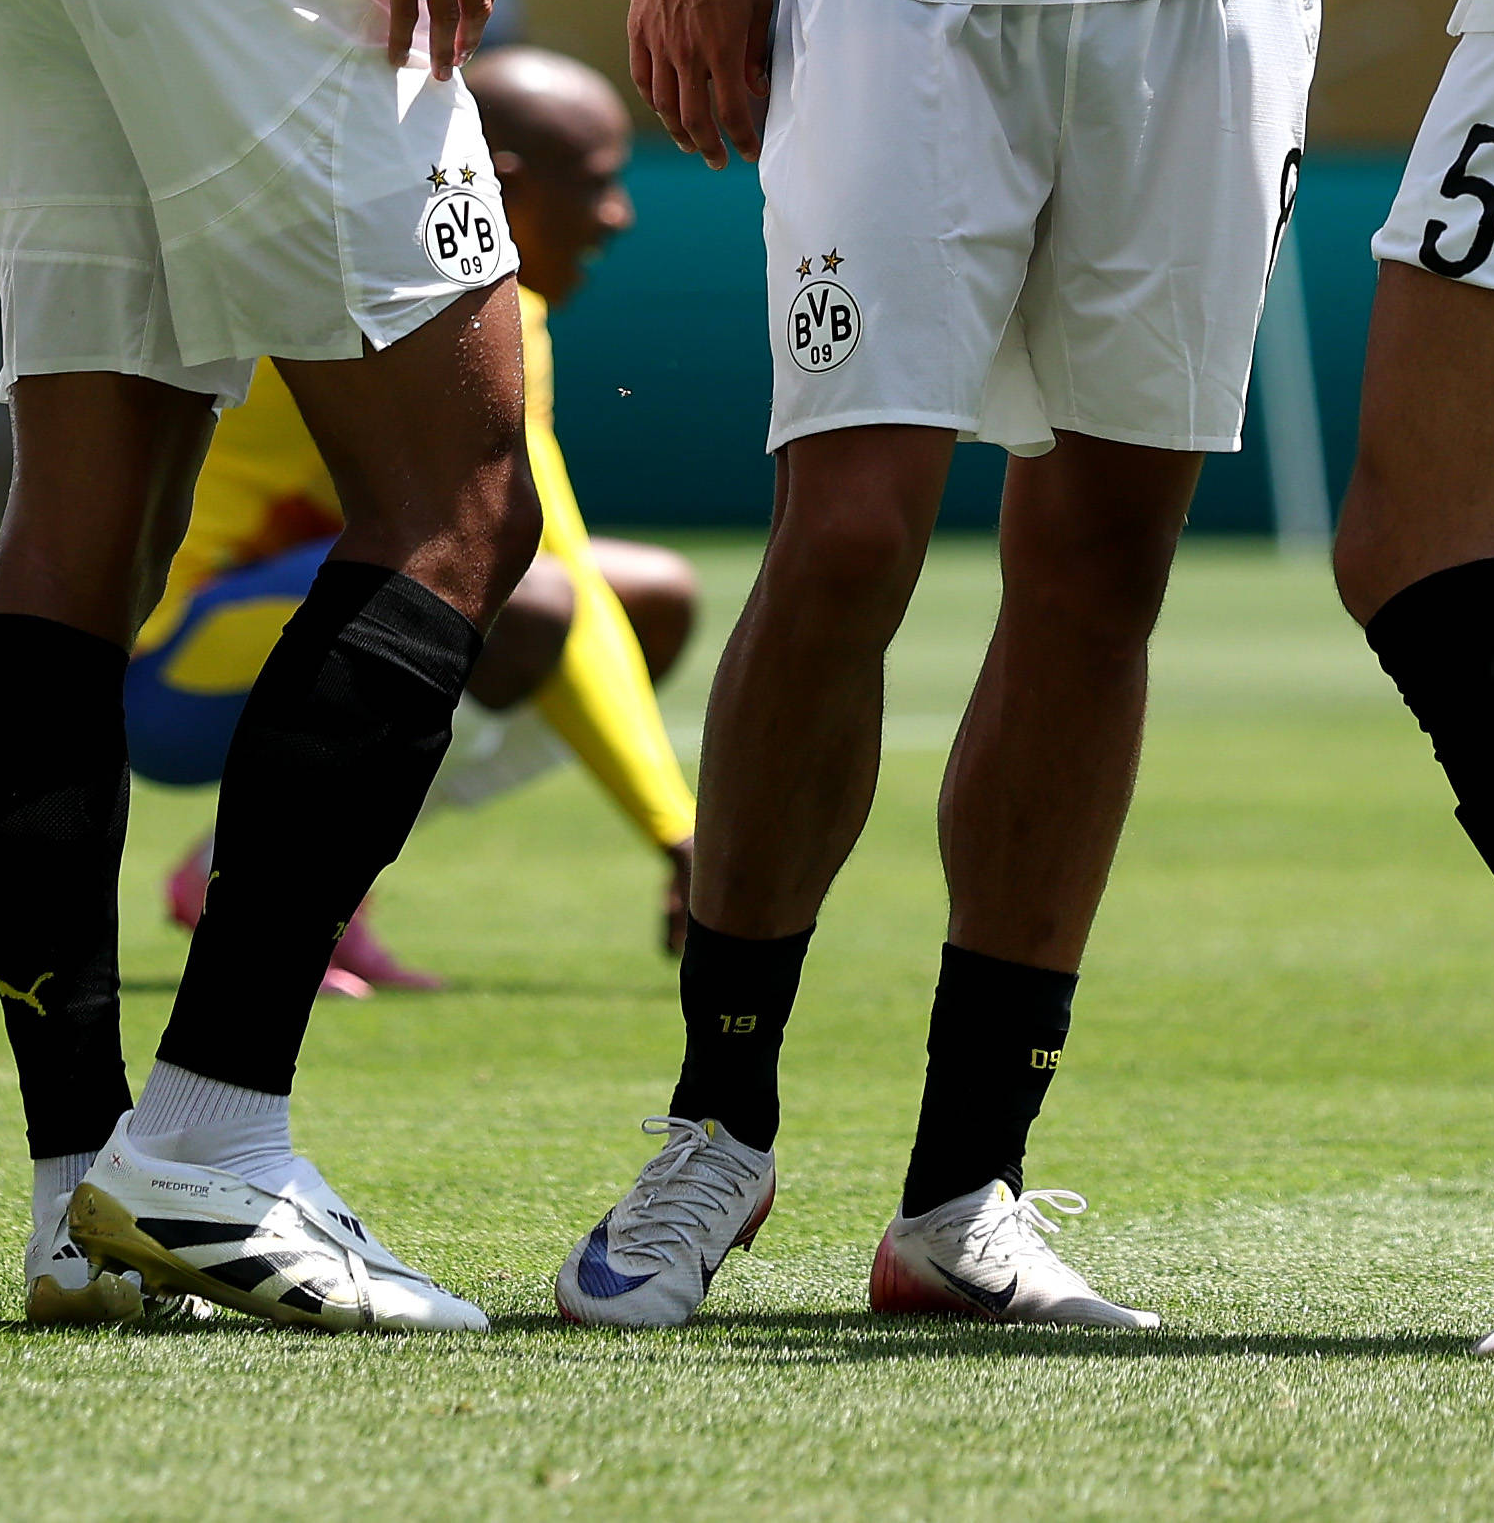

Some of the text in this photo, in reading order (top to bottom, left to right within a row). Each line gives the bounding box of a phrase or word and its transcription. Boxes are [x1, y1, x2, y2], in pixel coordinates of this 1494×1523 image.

[435, 200, 494, 259] BVB
[460, 255, 483, 276] 09
[794, 288, 852, 350] BVB
[810, 343, 832, 365] 09
[719, 1014, 757, 1033] 19
[1030, 1048, 1061, 1070] 09
[151, 1179, 210, 1194] PREDATOR
